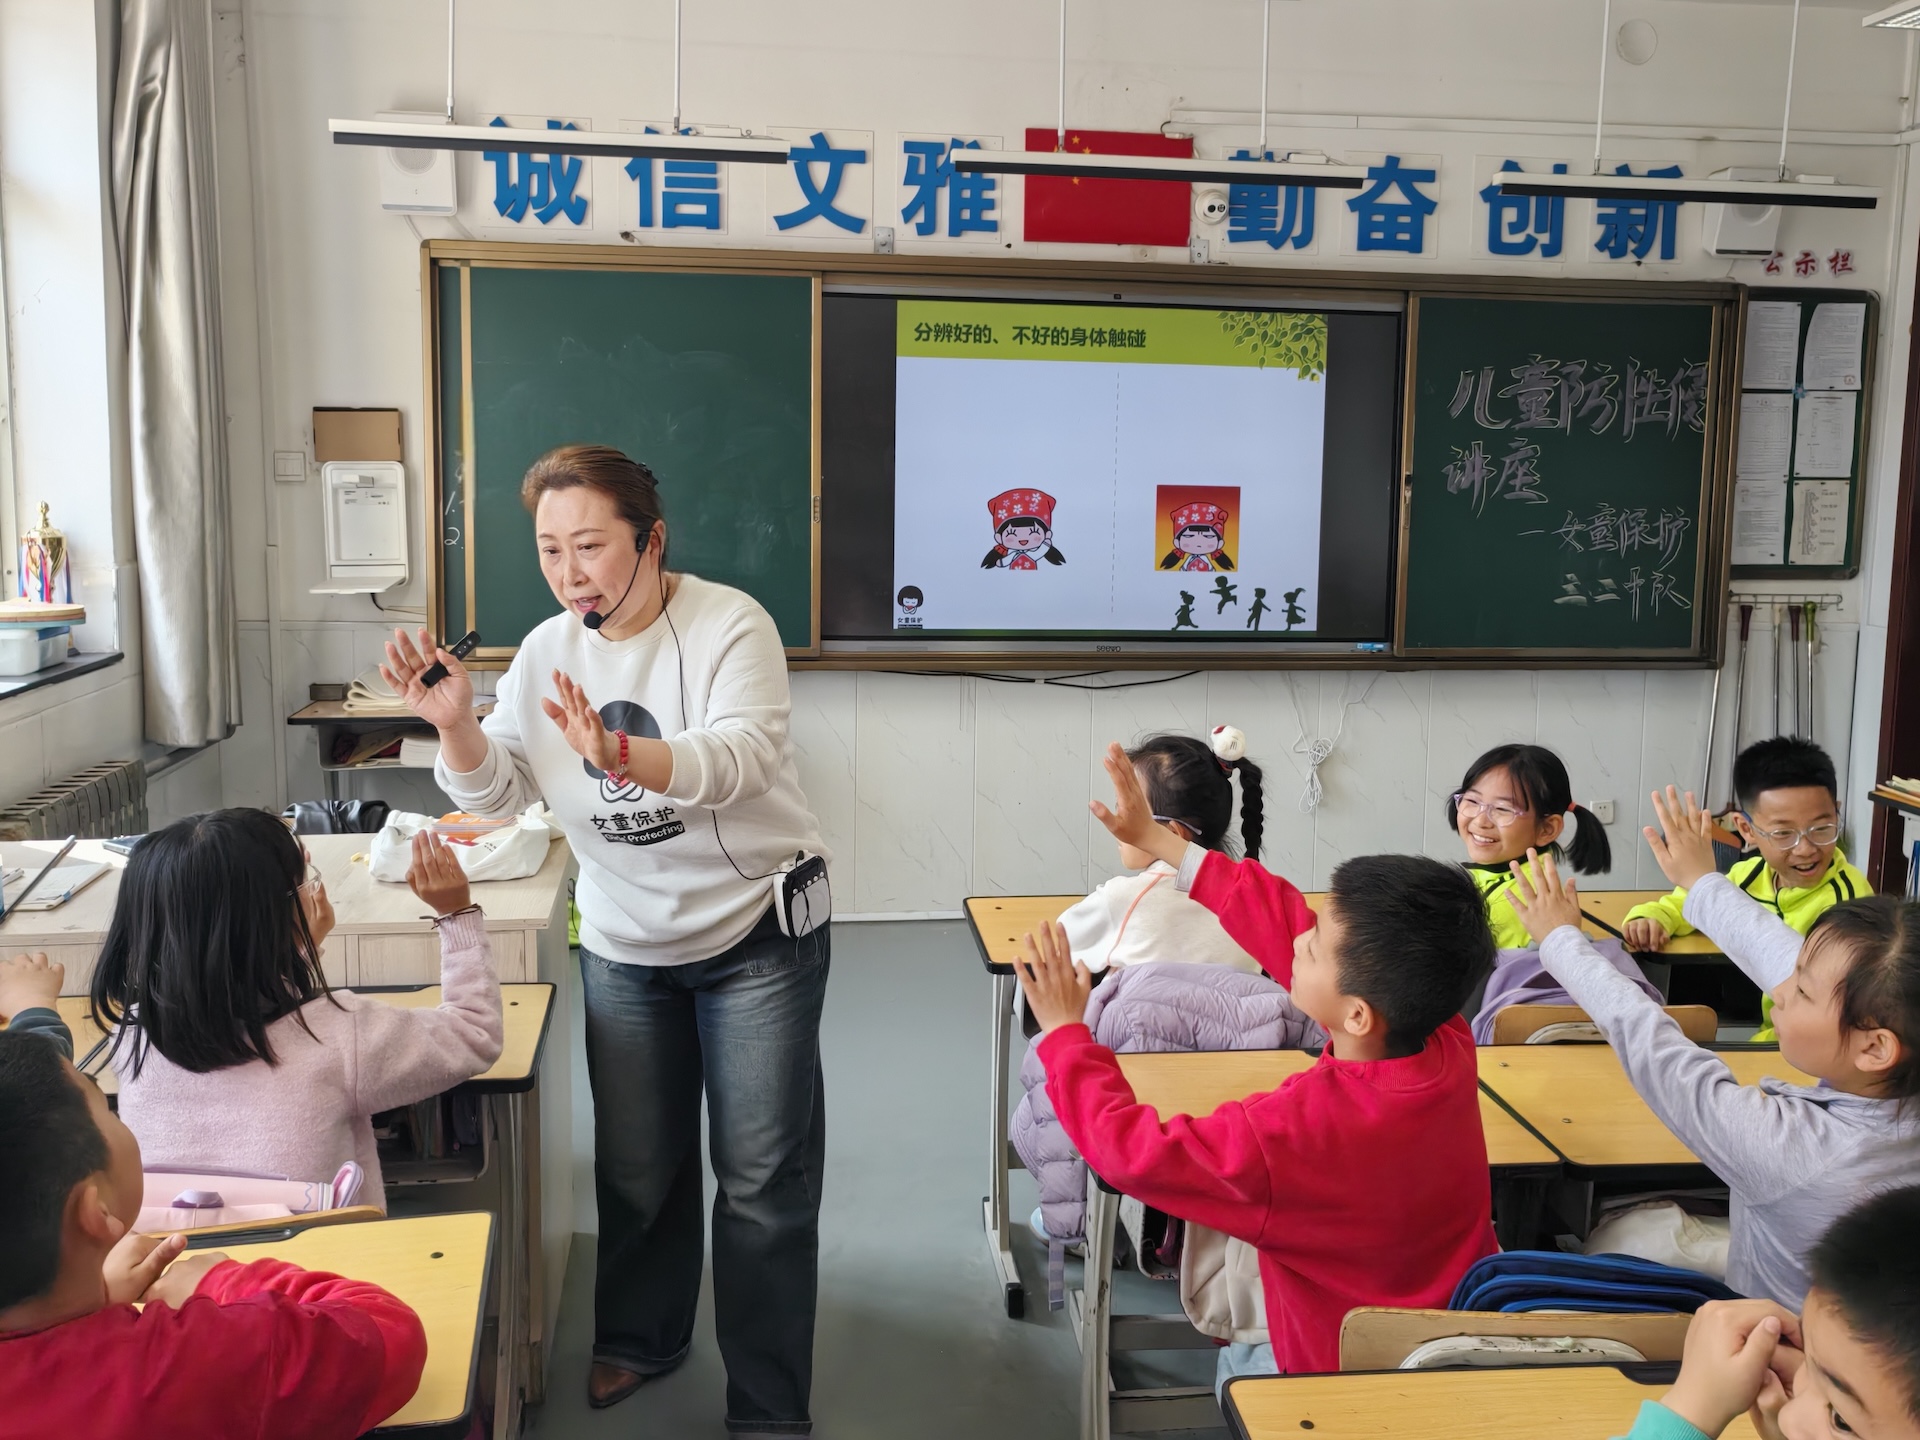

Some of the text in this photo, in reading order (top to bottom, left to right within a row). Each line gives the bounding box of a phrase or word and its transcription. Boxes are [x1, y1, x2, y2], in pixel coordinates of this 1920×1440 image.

[484, 116, 1684, 261] 诚信文雅 勤奋创新
[1762, 250, 1853, 276] 公示栏
[914, 322, 1147, 348] 分辨好的、不好的身体触碰
[1447, 353, 1709, 443] 儿童防性侵
[1441, 437, 1548, 519] 讲座
[590, 806, 675, 831] 女童保护
[627, 823, 684, 843] Protecting
